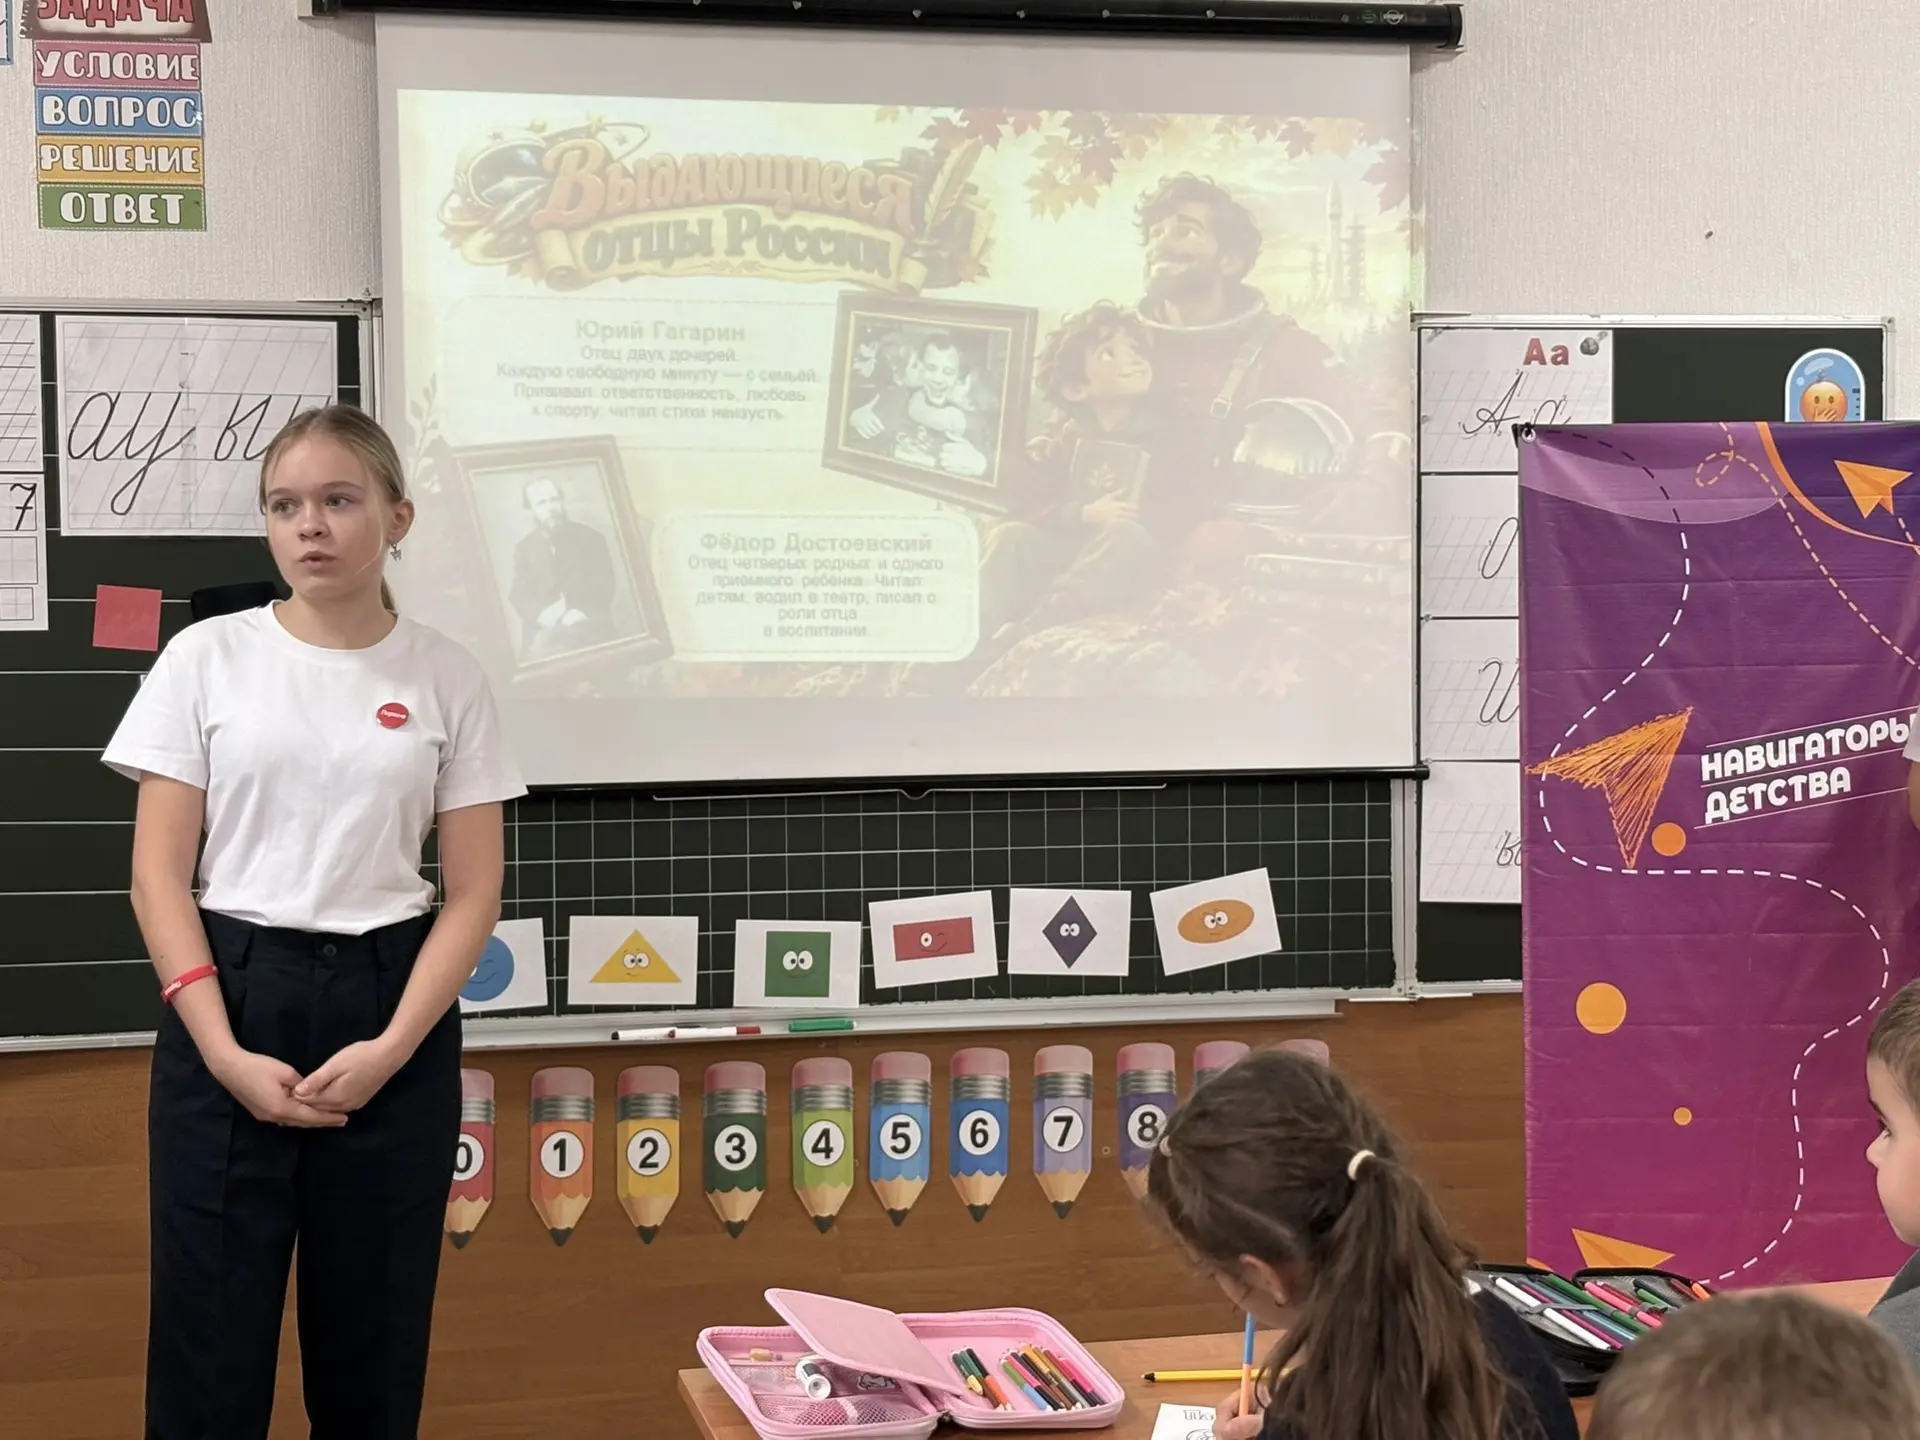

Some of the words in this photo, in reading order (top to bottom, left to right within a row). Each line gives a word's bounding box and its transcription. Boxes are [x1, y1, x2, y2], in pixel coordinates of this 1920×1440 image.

[36, 51, 199, 81] УСЛОВИЕ
[42, 95, 198, 128] ВОПРОС
[40, 144, 200, 173] РЕШЕНИЕ
[531, 138, 916, 238] Выдающиеся
[59, 192, 185, 225] ОТВЕТ
[582, 218, 714, 272] отцы
[722, 207, 893, 278] России
[576, 319, 644, 343] Юрий
[653, 321, 745, 344] Гагарин
[581, 346, 621, 362] Отец
[1522, 337, 1570, 366] Аа
[10, 482, 38, 531] 7
[700, 532, 776, 555] Фёдор
[784, 531, 933, 555] Достоевский
[688, 554, 728, 573] Отец
[813, 557, 870, 573] родных
[777, 608, 816, 622] роли
[821, 607, 858, 622] отца
[1701, 713, 1917, 781] НАВИГАТОРЫ
[1705, 766, 1852, 824] ДЕТСТВА
[811, 1126, 834, 1160] 4
[889, 1121, 911, 1155] 5
[969, 1117, 990, 1149] 6
[1053, 1115, 1074, 1147] 7
[1137, 1111, 1159, 1143] 8
[454, 1141, 473, 1173] 0
[553, 1138, 567, 1172] 1
[638, 1136, 660, 1169] 2
[724, 1132, 747, 1165] 3
